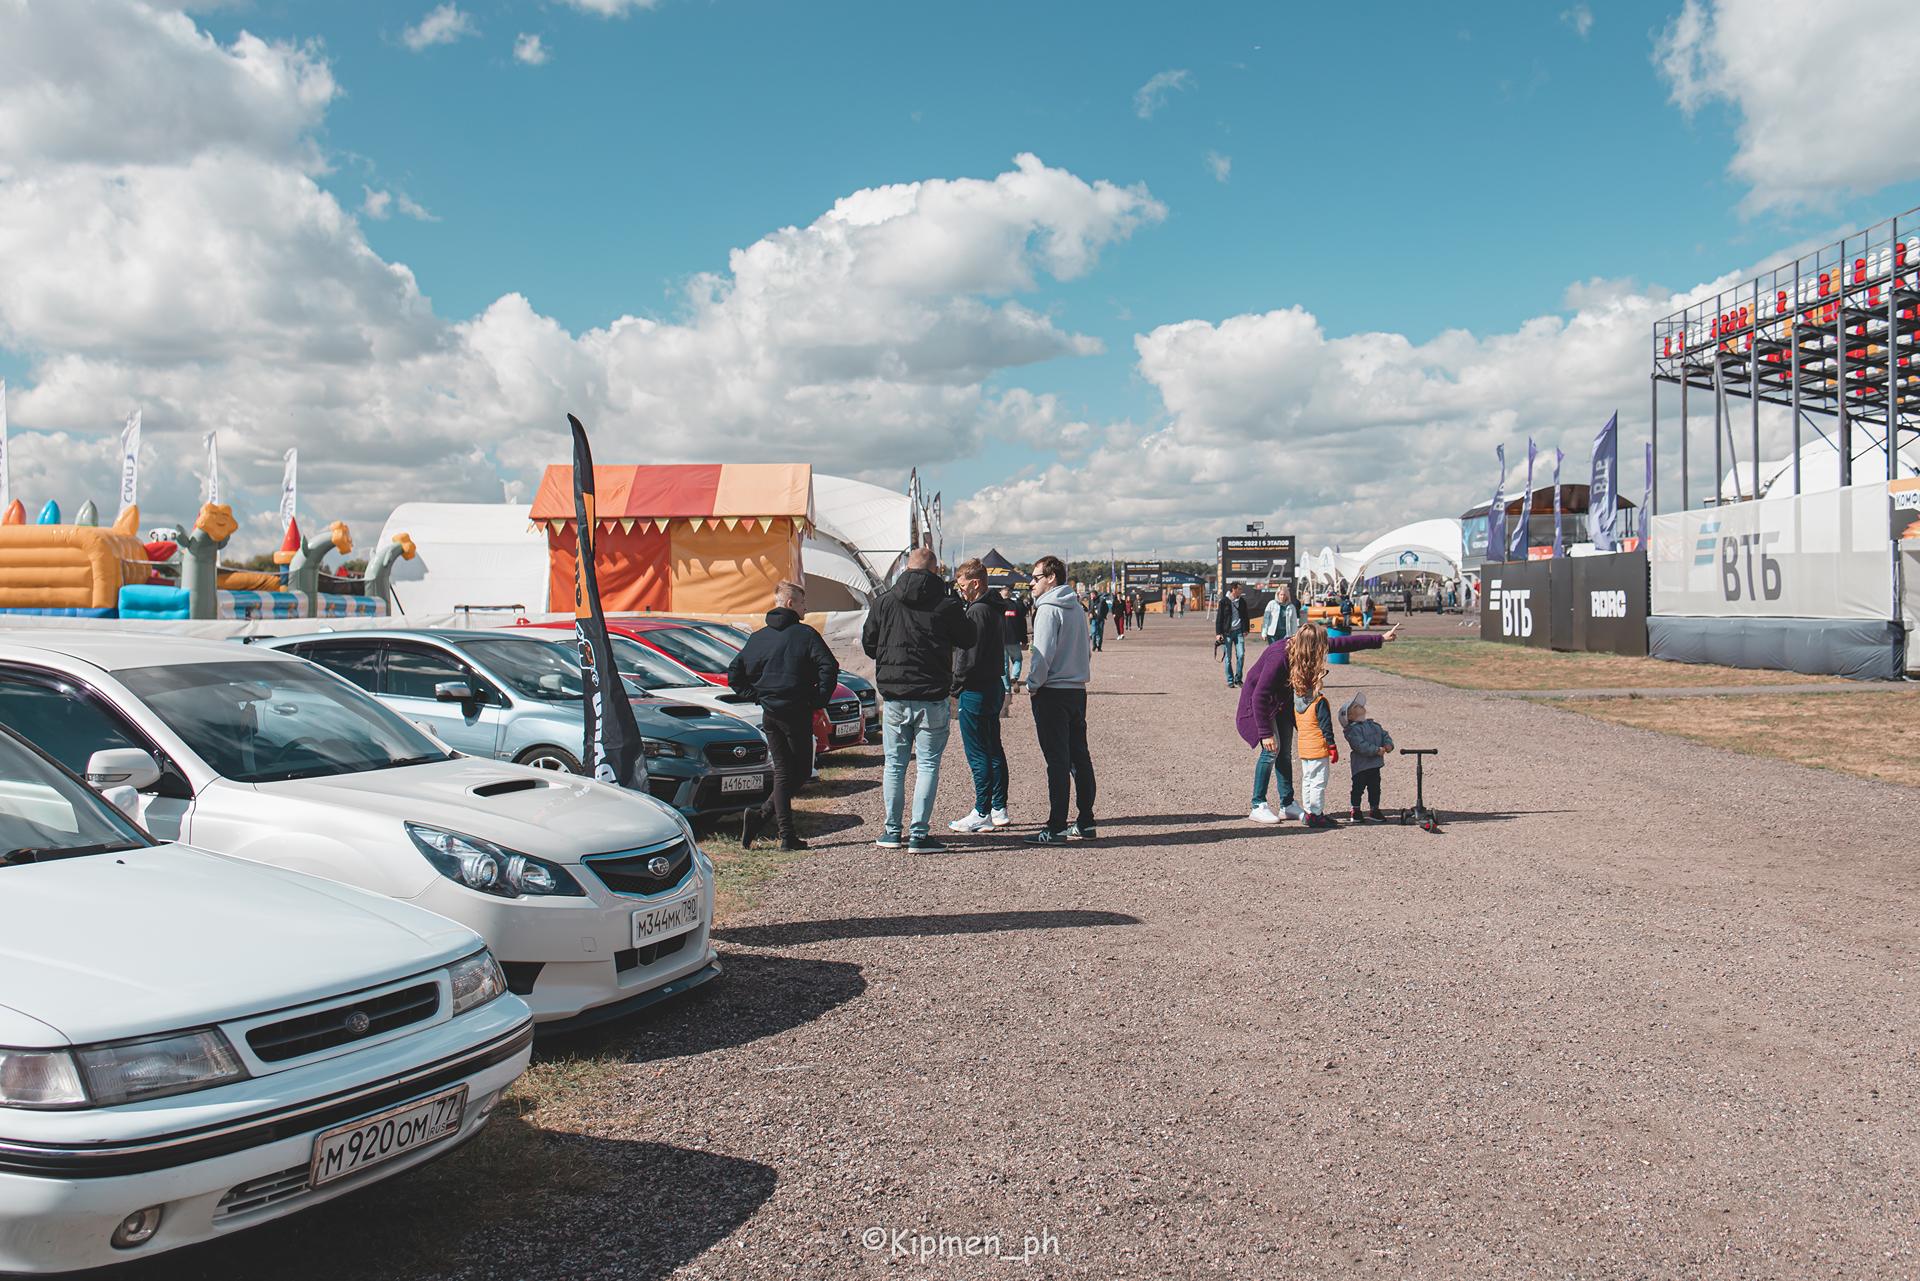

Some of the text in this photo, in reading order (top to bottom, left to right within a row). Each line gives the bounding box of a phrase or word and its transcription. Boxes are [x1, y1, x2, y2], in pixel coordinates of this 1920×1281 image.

[1721, 531, 1782, 601] ВТБ
[1502, 589, 1532, 638] ВТБ
[1591, 590, 1626, 618] RDRC
[638, 898, 696, 938] М344МК 790
[325, 1095, 457, 1176] М920ОМ 77
[430, 1123, 446, 1136] RUS
